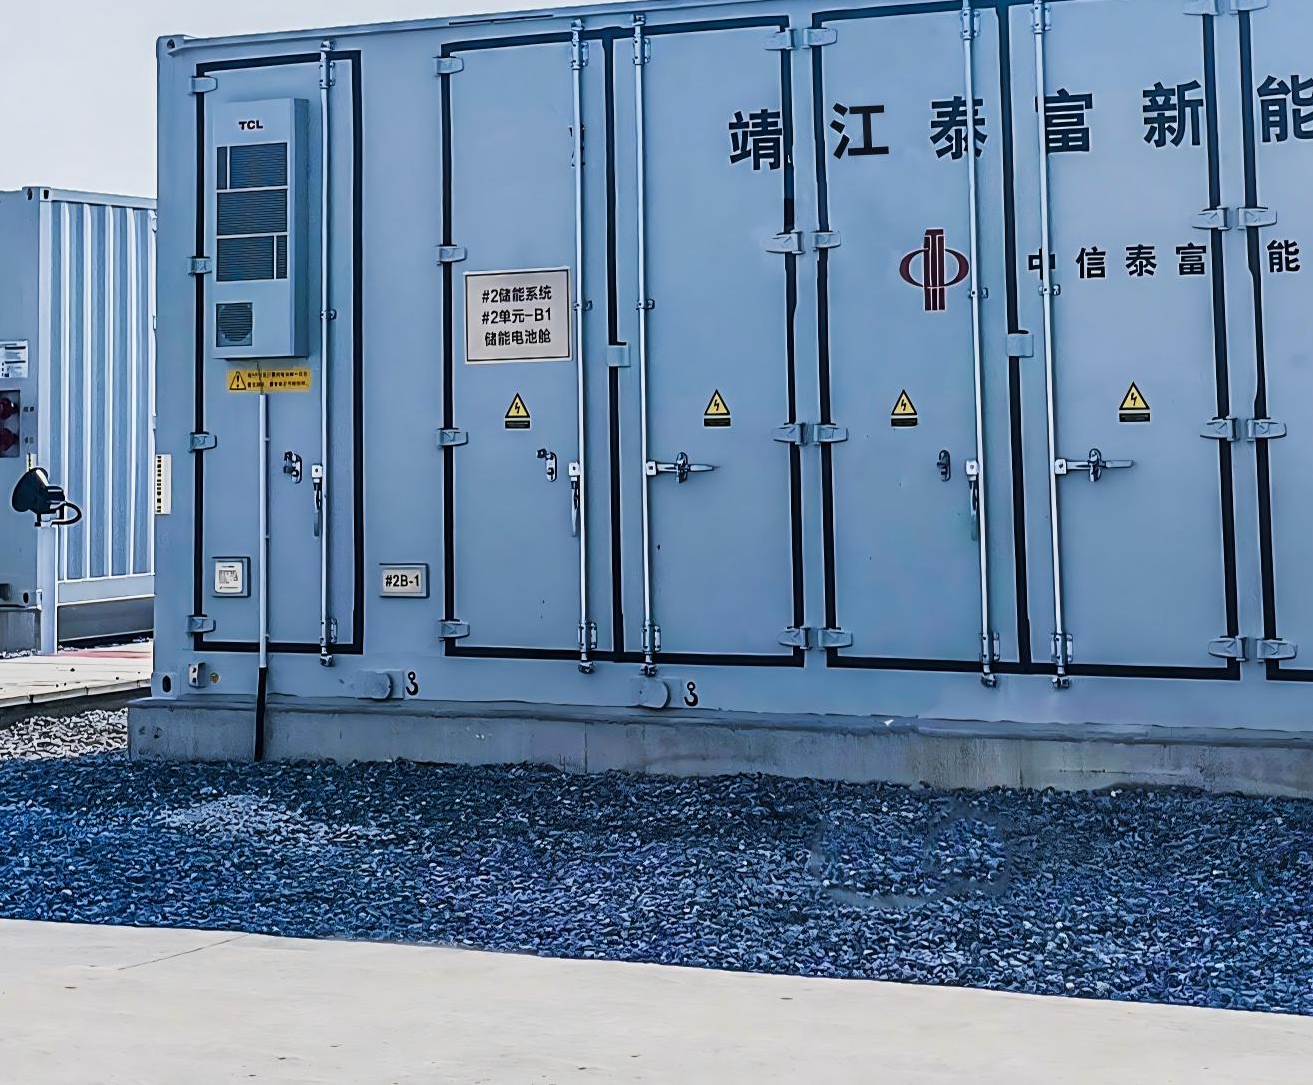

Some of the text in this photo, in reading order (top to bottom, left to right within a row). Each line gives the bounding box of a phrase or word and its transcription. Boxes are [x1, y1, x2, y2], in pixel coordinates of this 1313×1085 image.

[238, 119, 264, 130] TCL
[482, 284, 552, 303] #2储能系统
[484, 328, 551, 347] 储能电池舱
[385, 574, 420, 587] #2B-1
